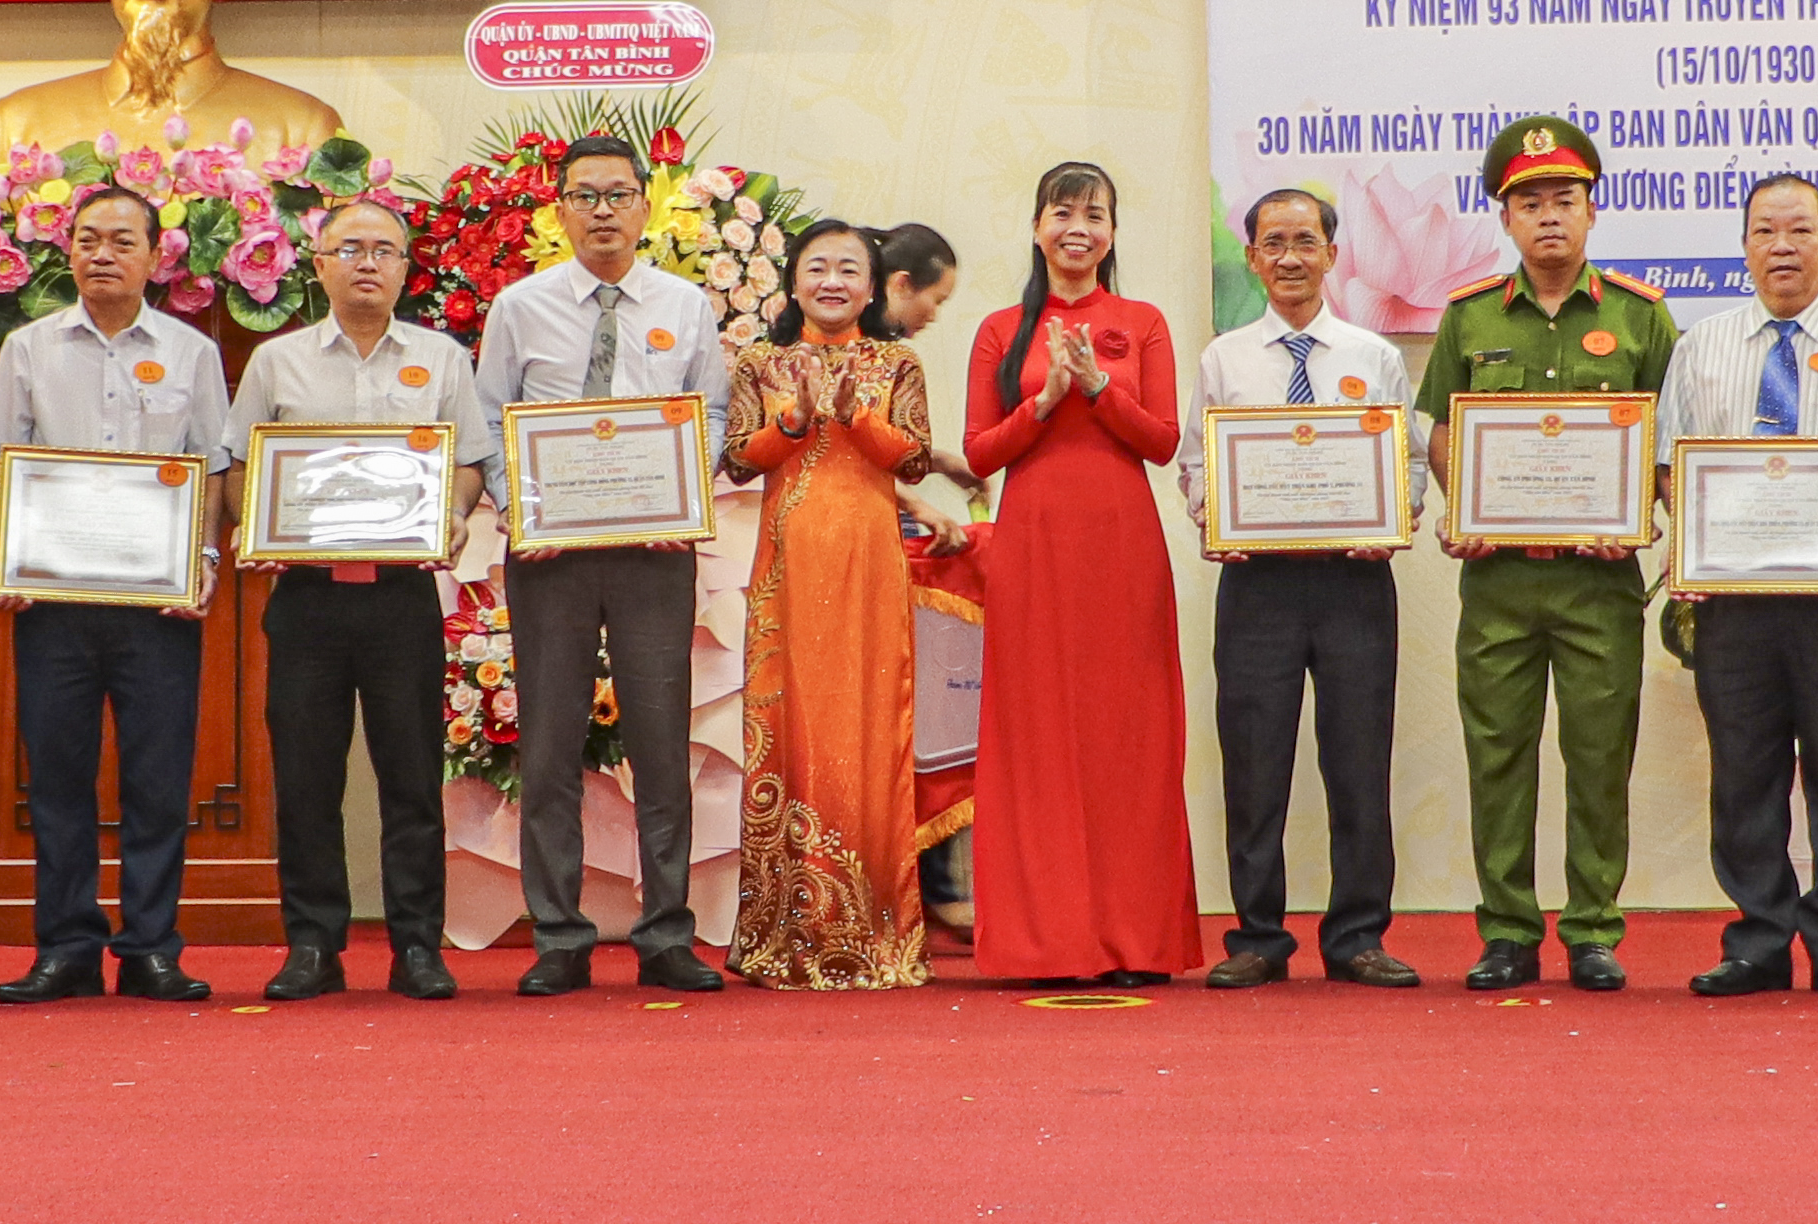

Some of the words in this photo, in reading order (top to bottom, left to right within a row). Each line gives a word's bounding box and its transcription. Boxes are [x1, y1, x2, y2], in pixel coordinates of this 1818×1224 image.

[481, 22, 516, 46] QUẬN
[517, 20, 536, 42] ỦY
[542, 24, 579, 42] UBND
[641, 19, 670, 44] VIỆT
[502, 43, 563, 65] QUẬN
[568, 45, 610, 61] TÂN
[614, 43, 671, 60] BÌNH
[1656, 44, 1816, 89] (15/10/1930
[502, 61, 581, 79] CHÚC
[588, 61, 675, 77] MỪNG
[1257, 116, 1290, 155] 30
[1299, 106, 1361, 154] NĂM
[1371, 105, 1443, 153] NGÀY
[1610, 109, 1666, 149] BAN
[1675, 100, 1730, 148] DÂN
[1738, 99, 1793, 156] VẬN
[1455, 167, 1489, 214] VÀ
[1594, 168, 1685, 211] DƯƠNG
[1645, 263, 1716, 294] Bình,
